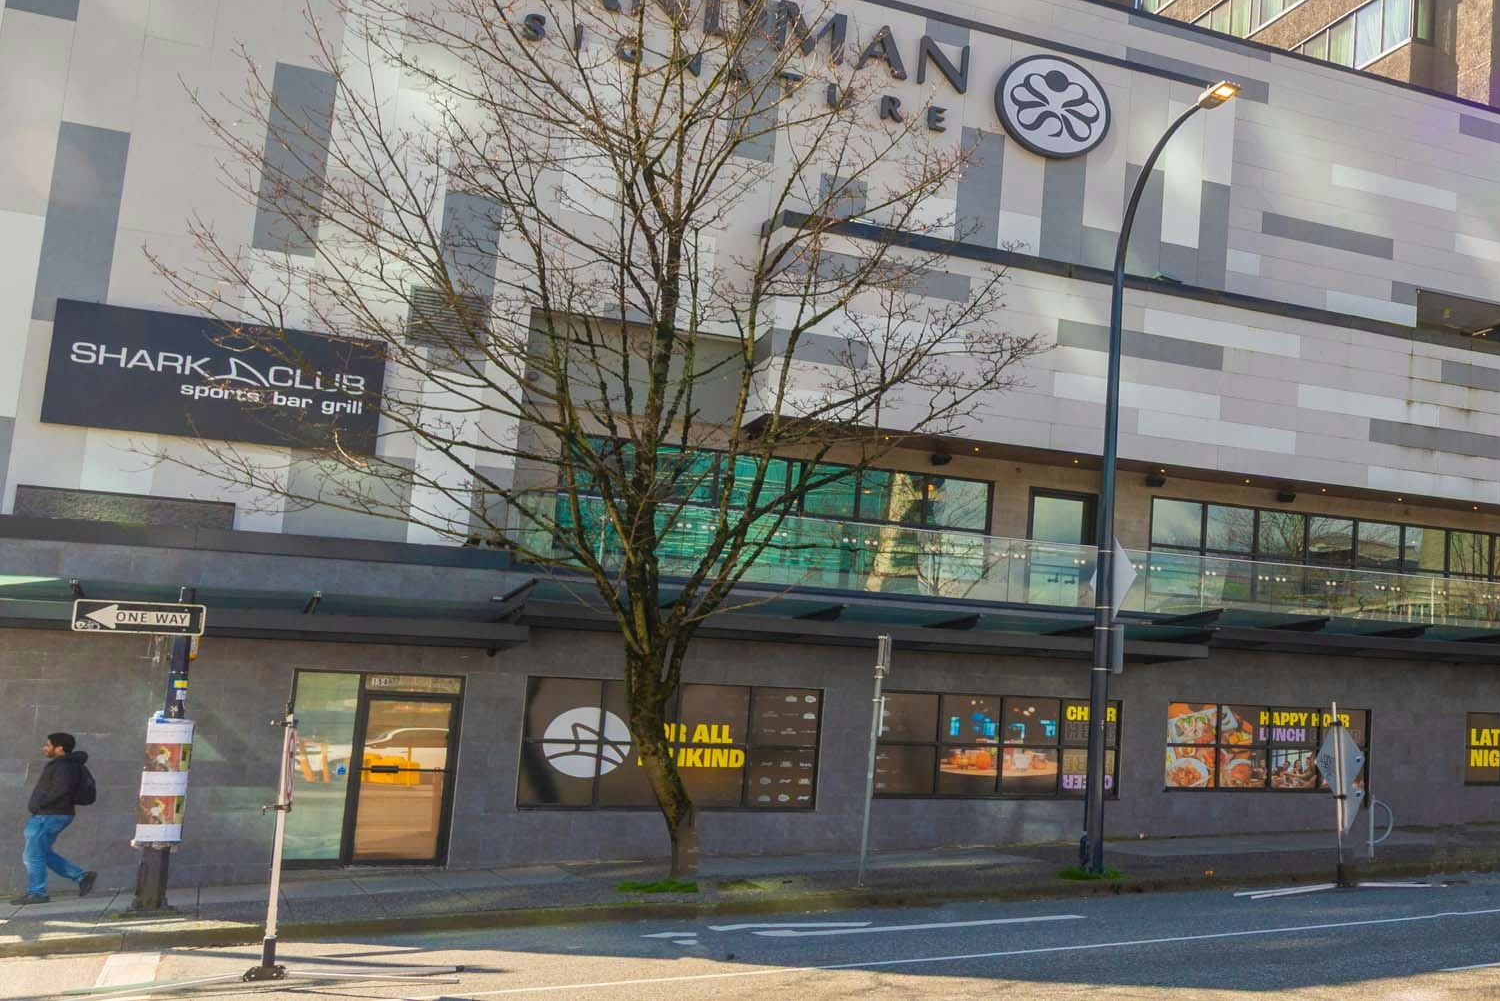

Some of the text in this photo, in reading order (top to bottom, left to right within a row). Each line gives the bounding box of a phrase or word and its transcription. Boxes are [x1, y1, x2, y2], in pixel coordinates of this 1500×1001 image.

[70, 342, 365, 395] SHARK CLUB
[180, 384, 363, 415] sports bar grill
[116, 611, 188, 625] ONE WAY
[1066, 705, 1117, 722] CHR
[1260, 710, 1350, 728] HAPPY HOR
[692, 724, 733, 744] ALL
[1259, 726, 1306, 742] LUNCH
